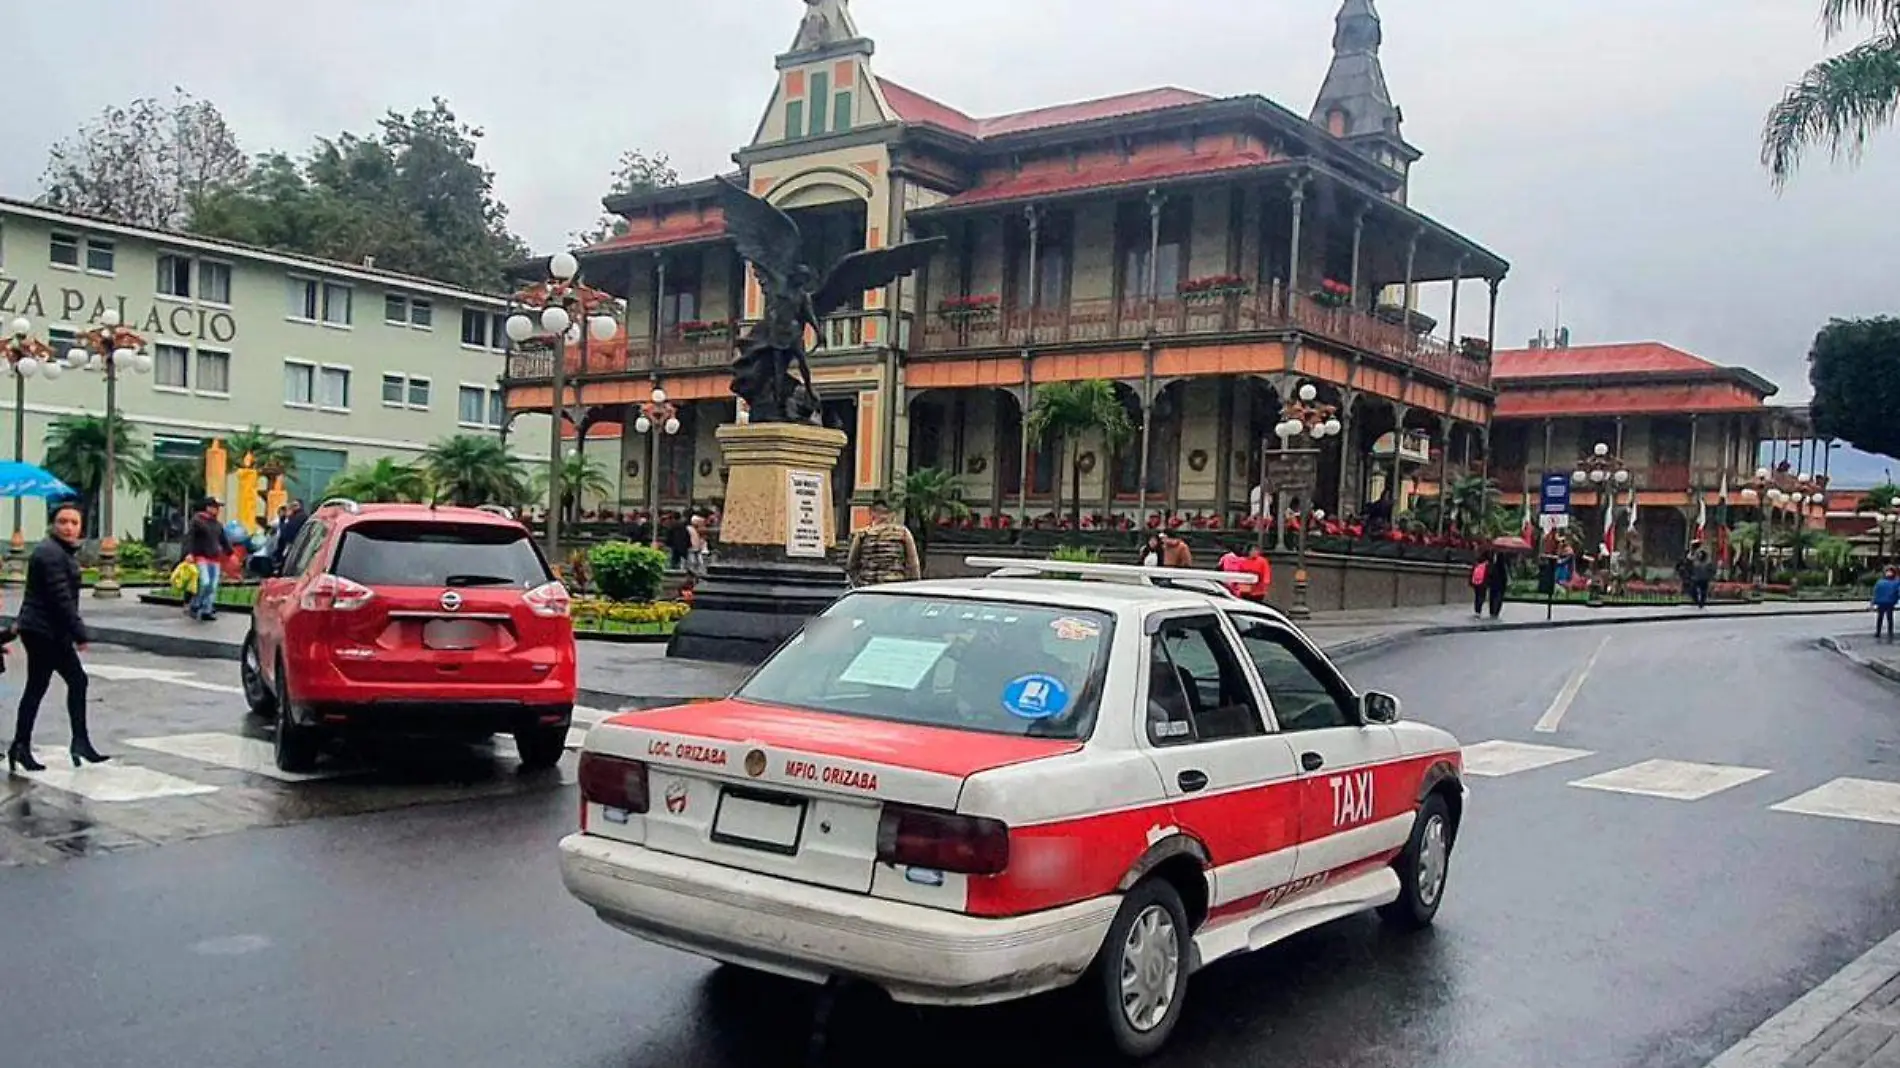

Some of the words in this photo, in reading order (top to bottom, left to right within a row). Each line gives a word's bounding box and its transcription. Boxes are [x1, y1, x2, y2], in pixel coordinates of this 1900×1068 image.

[60, 287, 236, 343] PALACIO
[648, 739, 672, 756] LOC.
[675, 743, 726, 765] ORIZABA
[785, 760, 818, 781] MPIO.
[822, 766, 877, 791] ORIZABA
[1330, 769, 1374, 827] TAXI
